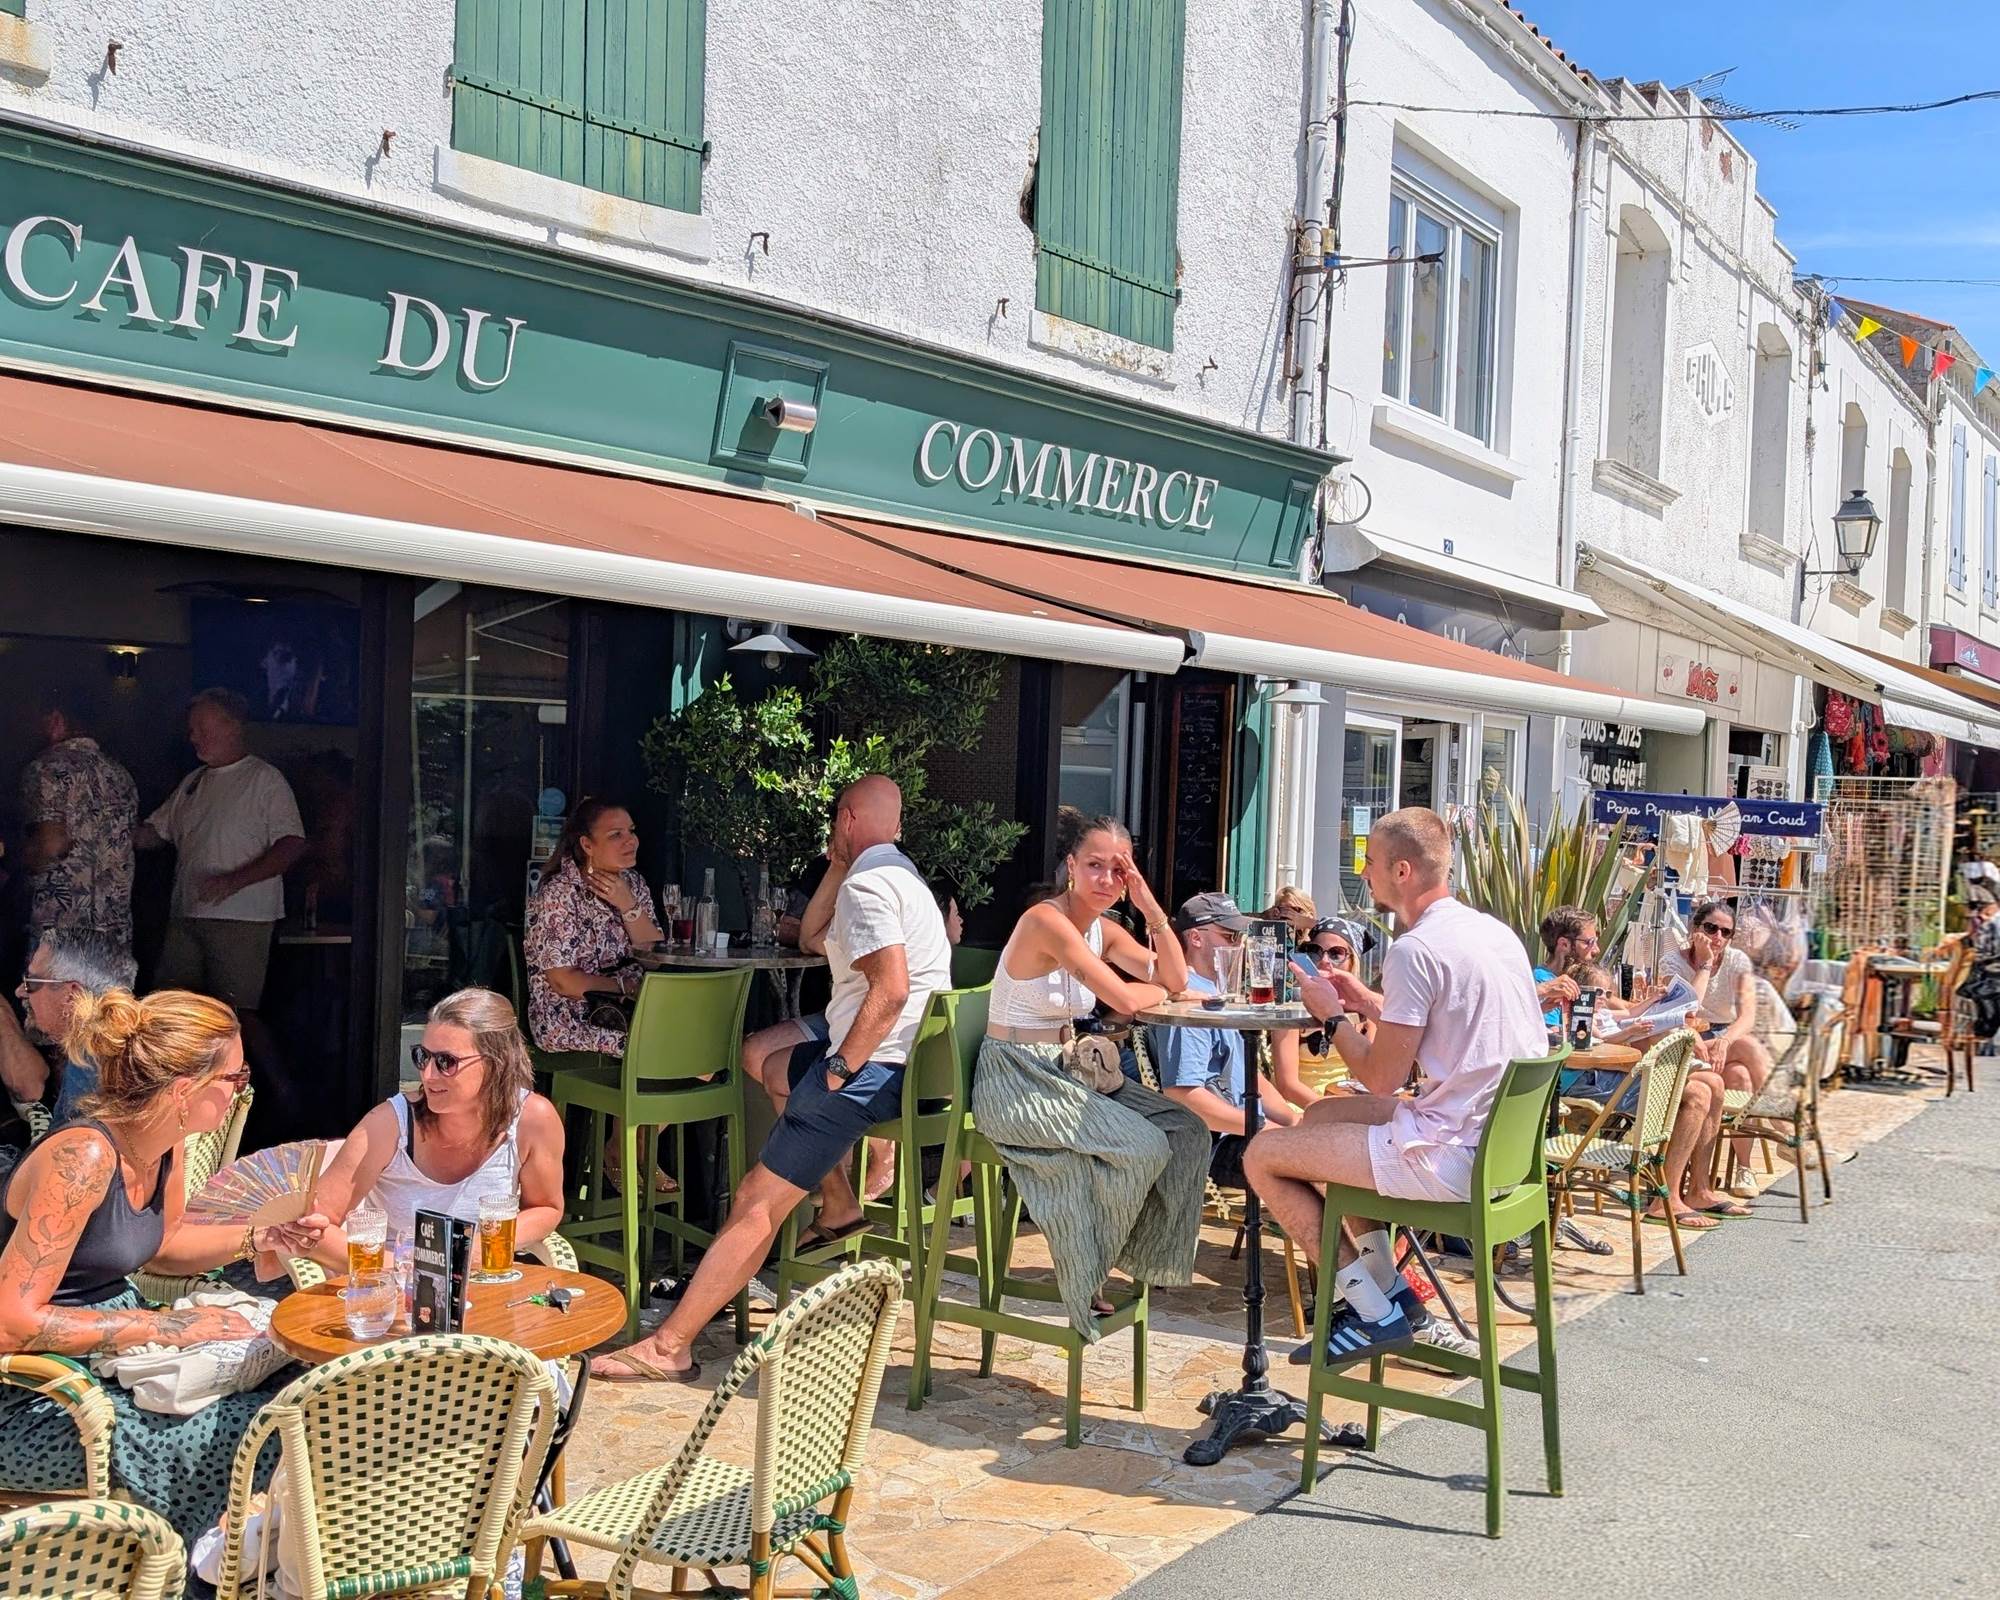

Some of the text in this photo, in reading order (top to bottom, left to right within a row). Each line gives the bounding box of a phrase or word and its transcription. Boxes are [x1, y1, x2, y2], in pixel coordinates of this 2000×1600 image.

[4, 215, 527, 386] CAFE DU
[920, 420, 1219, 531] COMMERCE
[1445, 540, 1452, 554] 21
[1581, 719, 1606, 743] 2005
[1616, 724, 1643, 749] 2025
[1591, 763, 1611, 784] ans
[1612, 758, 1636, 792] déjà
[1708, 806, 1764, 824] Man
[1767, 811, 1807, 826] Coud
[1262, 924, 1275, 936] CAFÉ
[420, 1222, 435, 1239] CAFÉ
